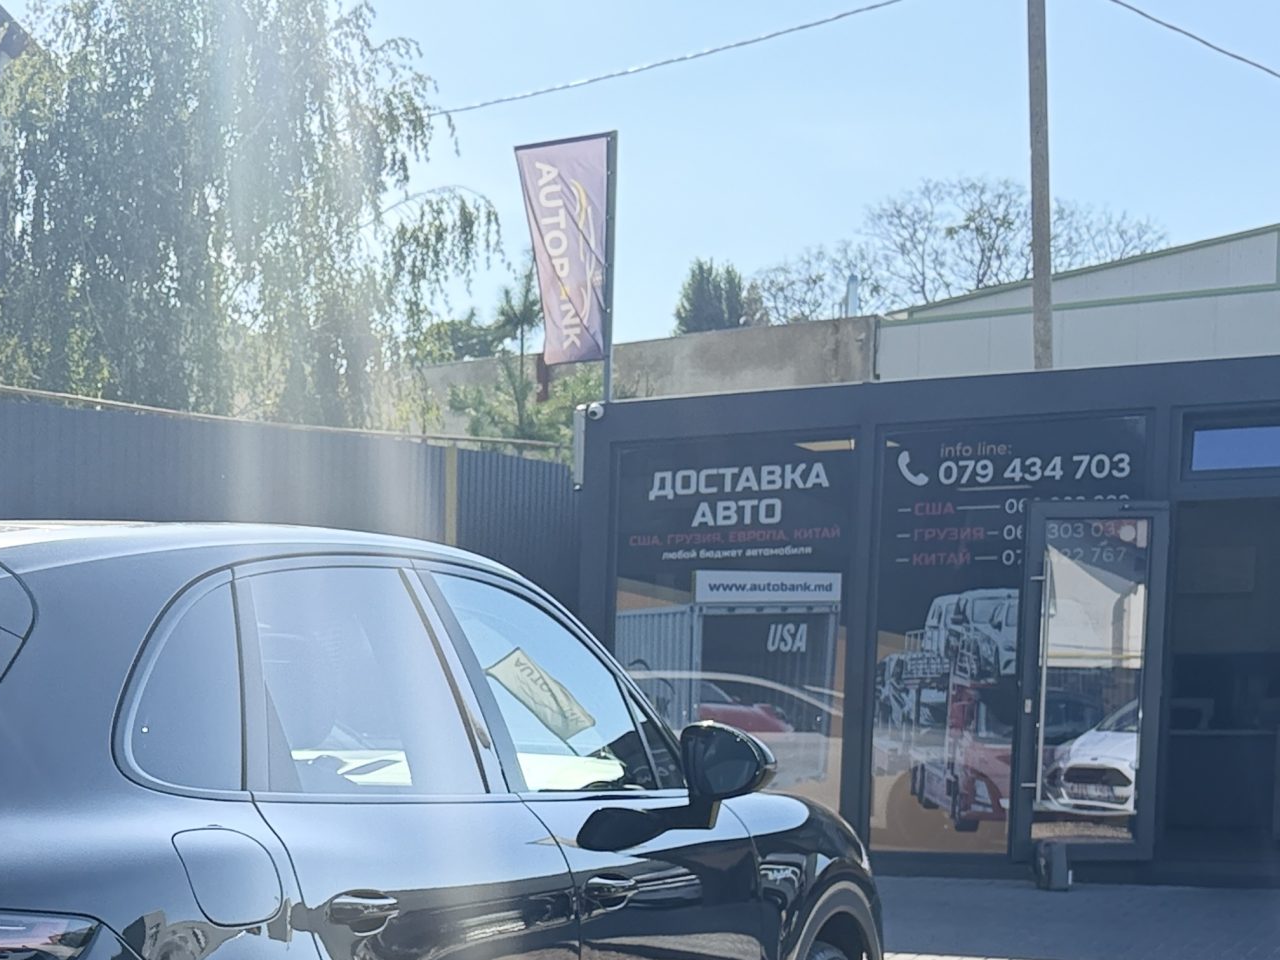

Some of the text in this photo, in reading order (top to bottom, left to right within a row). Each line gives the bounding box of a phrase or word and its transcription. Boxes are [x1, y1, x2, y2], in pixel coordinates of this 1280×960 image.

[940, 442, 1012, 457] info line:
[938, 453, 1131, 485] 079 434 703
[648, 462, 829, 501] ДОСТАВКА
[691, 498, 782, 527] АВТО
[914, 501, 956, 517] США
[794, 522, 841, 540] КИТАЙ
[914, 527, 985, 542] ГРУЗИЯ
[1047, 522, 1085, 539] 303
[1091, 521, 1117, 539] 03
[661, 544, 813, 560] любой бюджет автомобиля
[913, 547, 971, 567] КИТАЙ
[708, 580, 833, 594] www.autobank.md
[766, 623, 808, 653] USA
